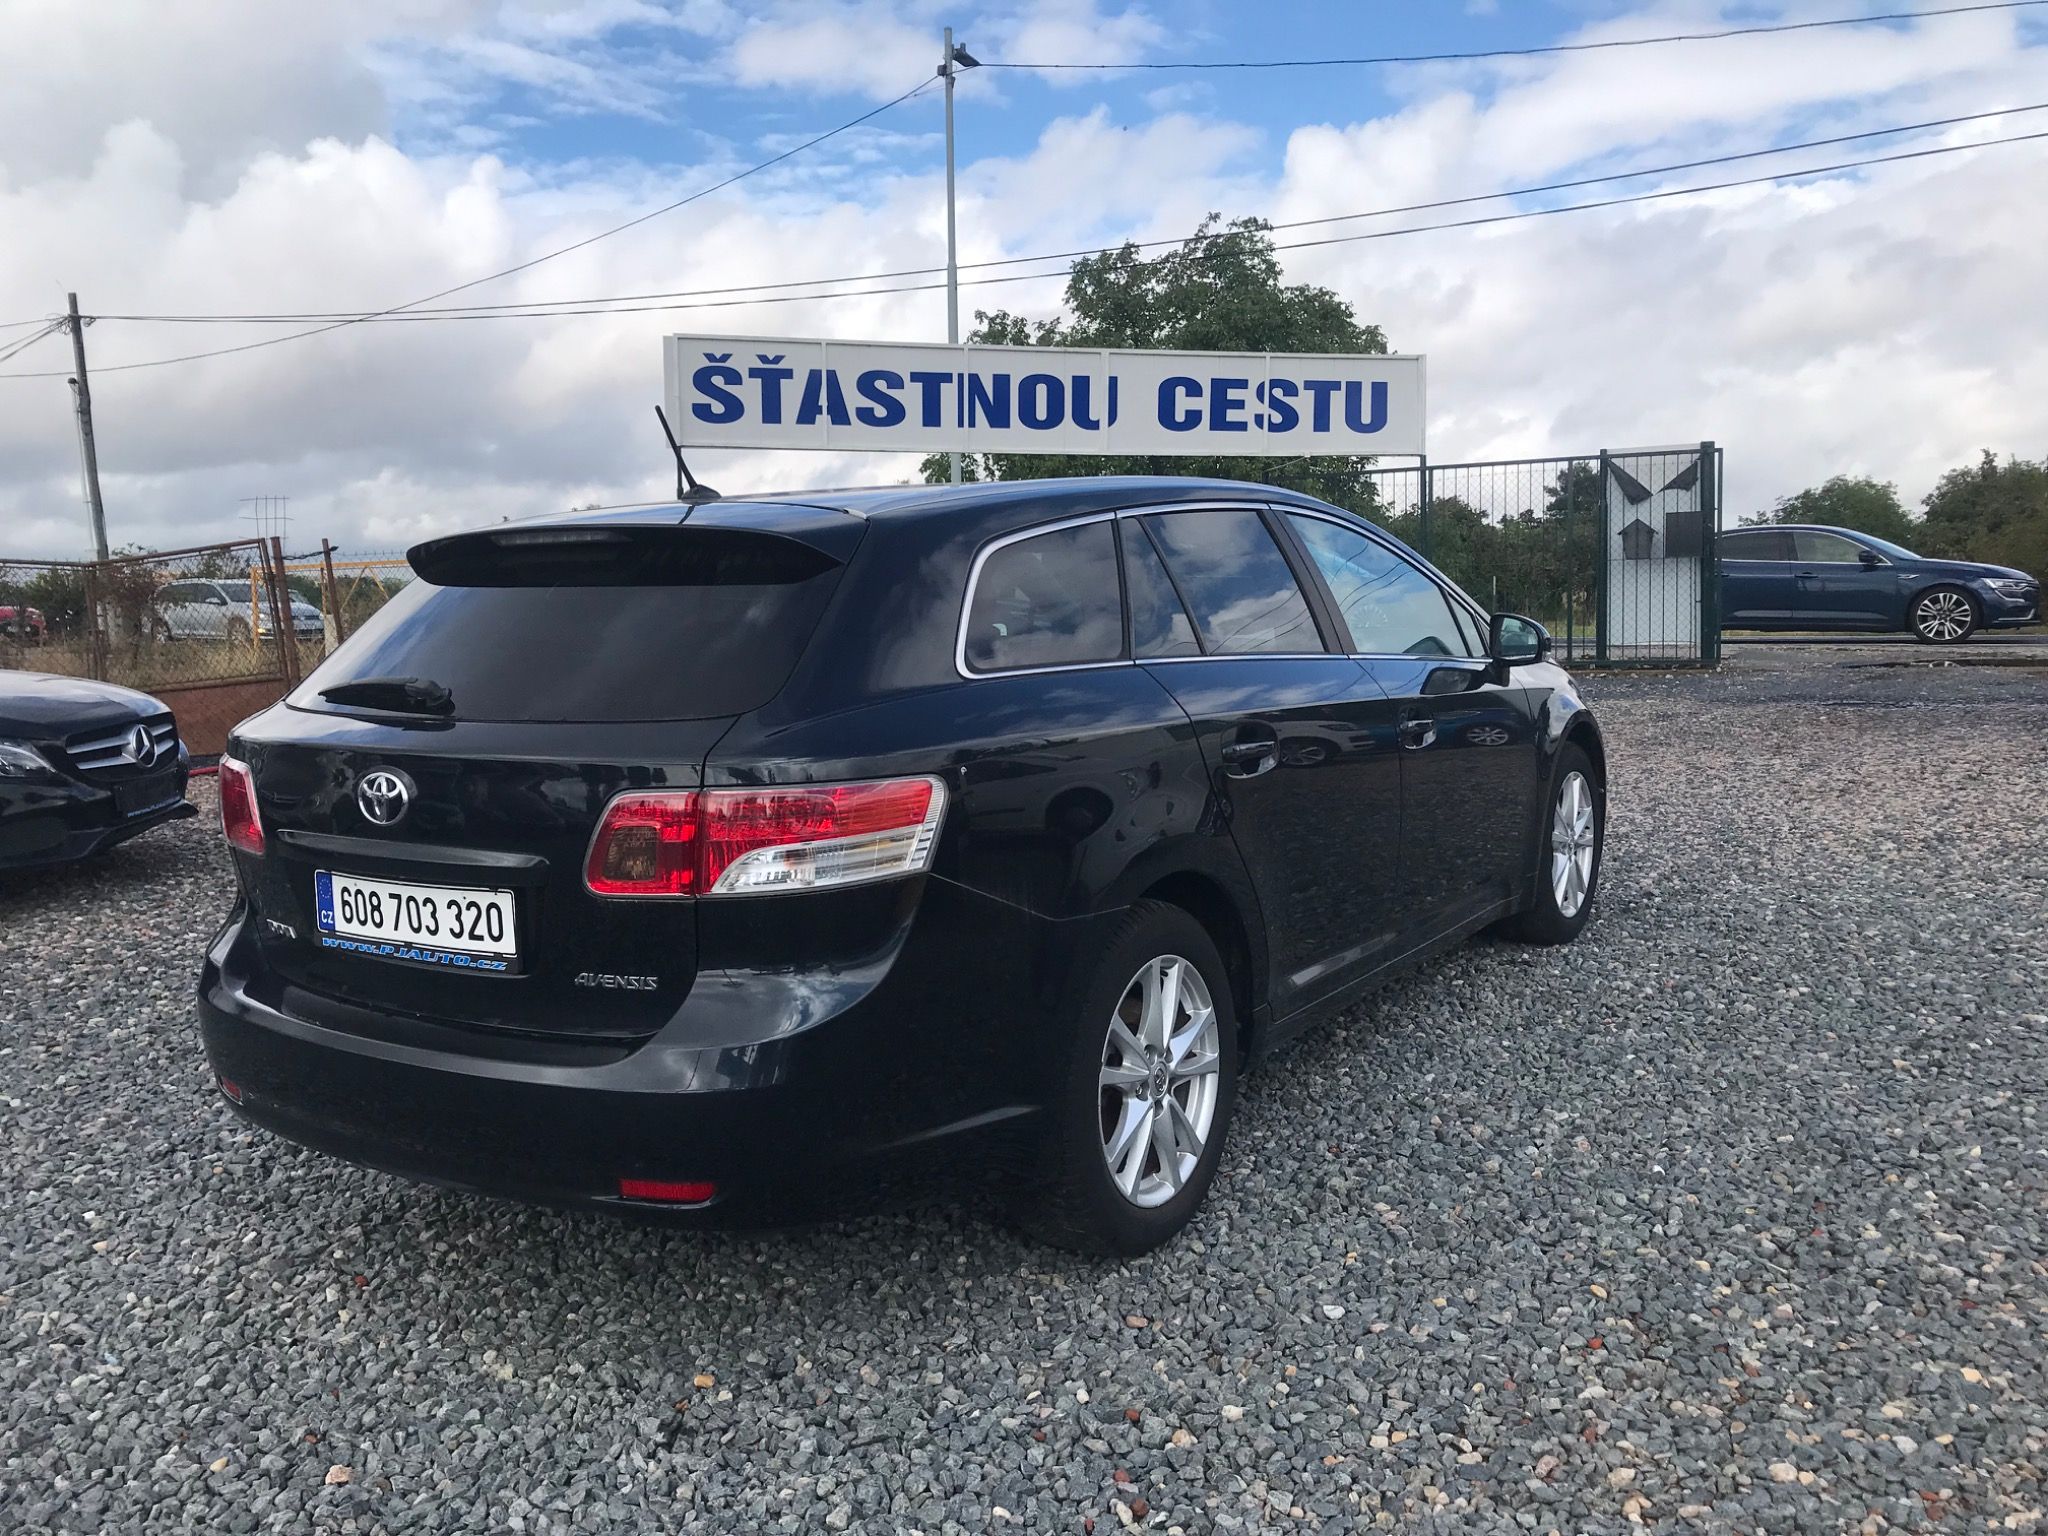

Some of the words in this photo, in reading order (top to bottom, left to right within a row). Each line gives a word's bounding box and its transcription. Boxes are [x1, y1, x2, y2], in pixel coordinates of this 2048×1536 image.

[692, 353, 1118, 430] ŠŤASTNOU
[1158, 376, 1388, 433] CESTU
[321, 909, 334, 924] CZ
[340, 886, 384, 929] 608
[388, 892, 440, 937] 703
[446, 899, 504, 943] 320
[574, 972, 658, 991] AVENSIS
